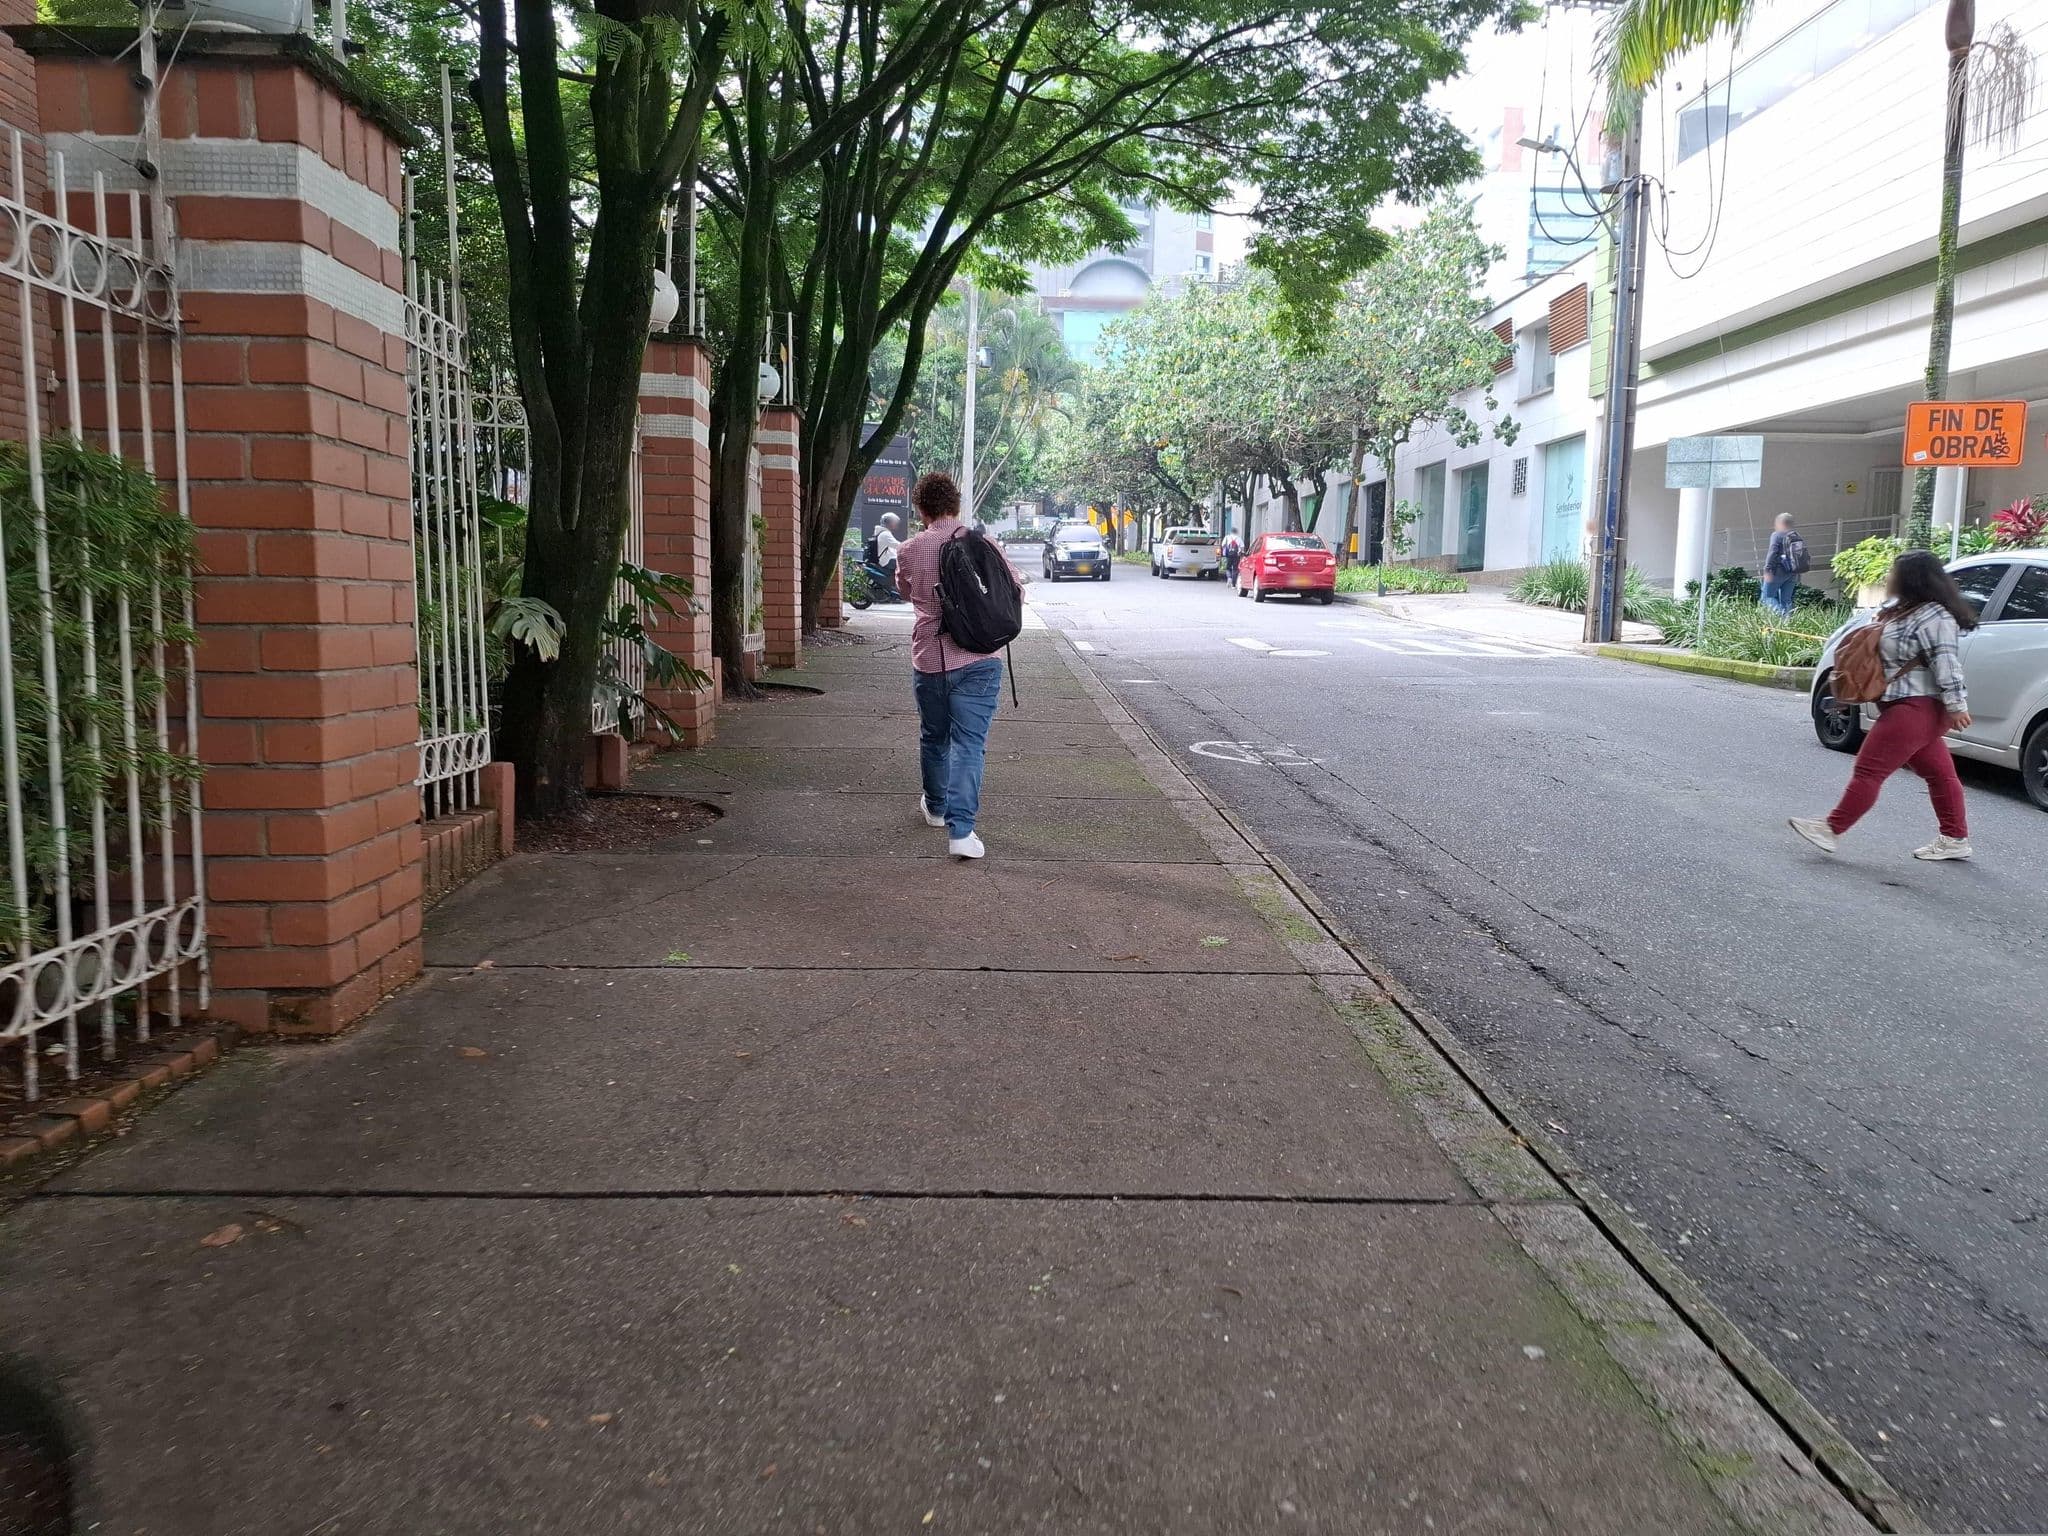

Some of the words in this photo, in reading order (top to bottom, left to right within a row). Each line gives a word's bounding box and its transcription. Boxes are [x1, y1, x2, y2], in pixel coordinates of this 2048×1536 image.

[1929, 409, 1963, 432] FIN
[1974, 408, 2004, 431] DE
[1929, 435, 1996, 459] OBRA
